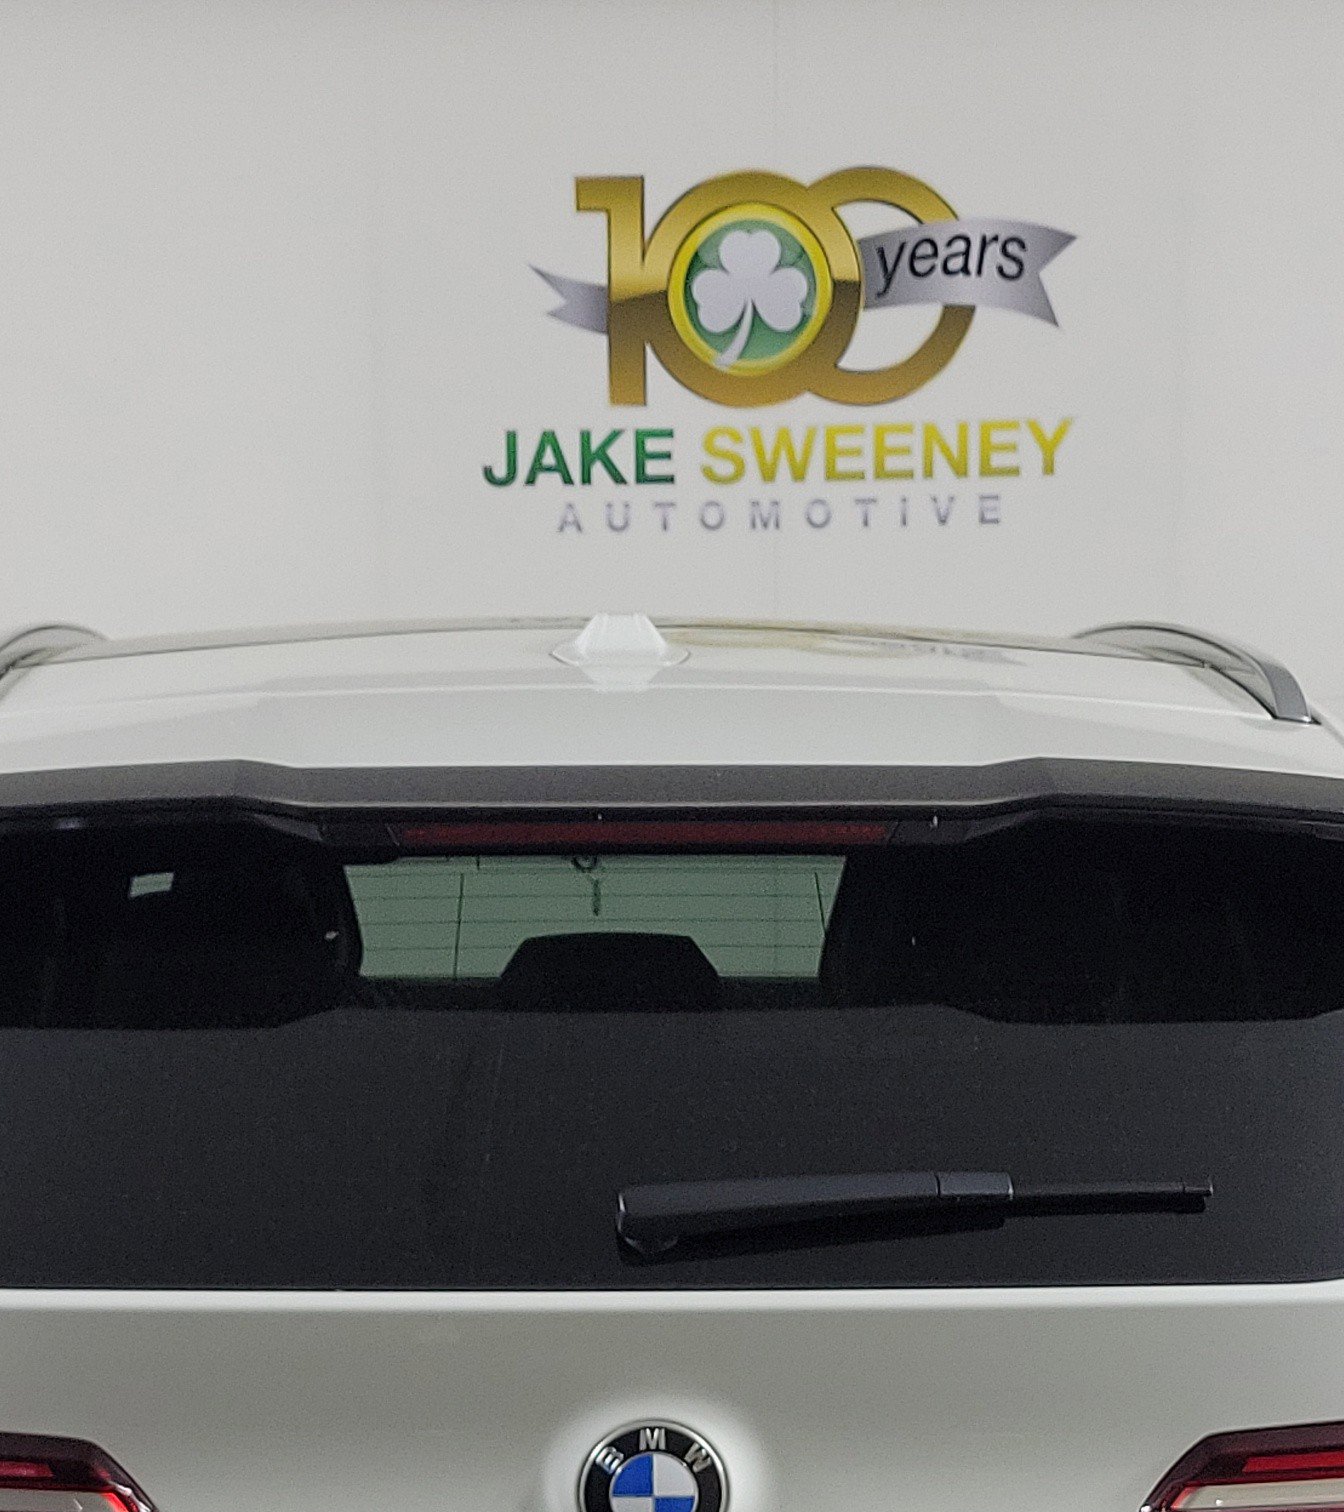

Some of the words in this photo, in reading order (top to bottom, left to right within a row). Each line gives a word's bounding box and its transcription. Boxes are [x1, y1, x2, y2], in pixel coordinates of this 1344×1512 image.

[574, 166, 976, 407] 100
[874, 229, 1028, 297] years
[482, 428, 675, 487] JAKE
[700, 418, 1074, 485] SWEENEY
[556, 495, 1002, 533] AUTOMOTIVE
[595, 1428, 712, 1474] BMW
